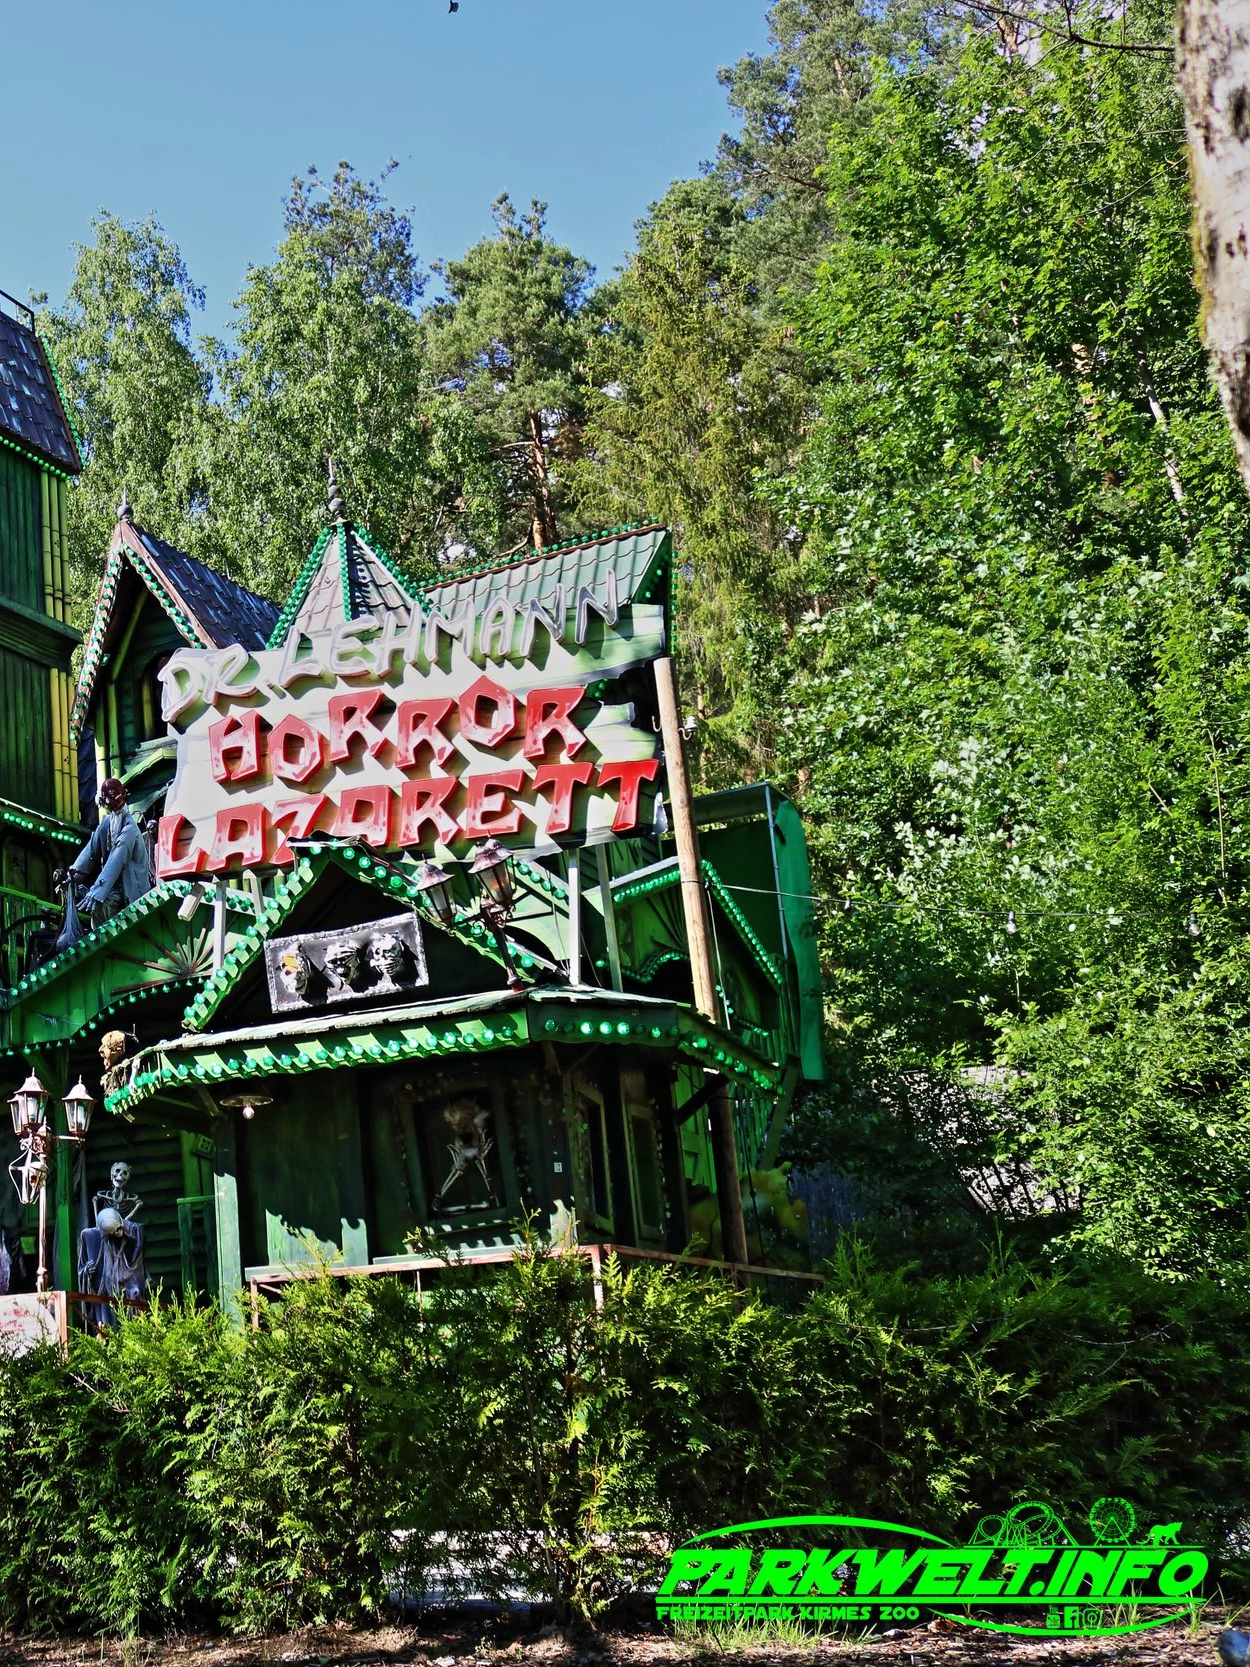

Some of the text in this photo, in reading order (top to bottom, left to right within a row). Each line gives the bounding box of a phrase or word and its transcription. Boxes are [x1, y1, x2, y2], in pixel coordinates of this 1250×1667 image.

[278, 568, 619, 688] LEHMANN
[208, 675, 588, 783] HORROR
[156, 758, 660, 879] LAZARETT
